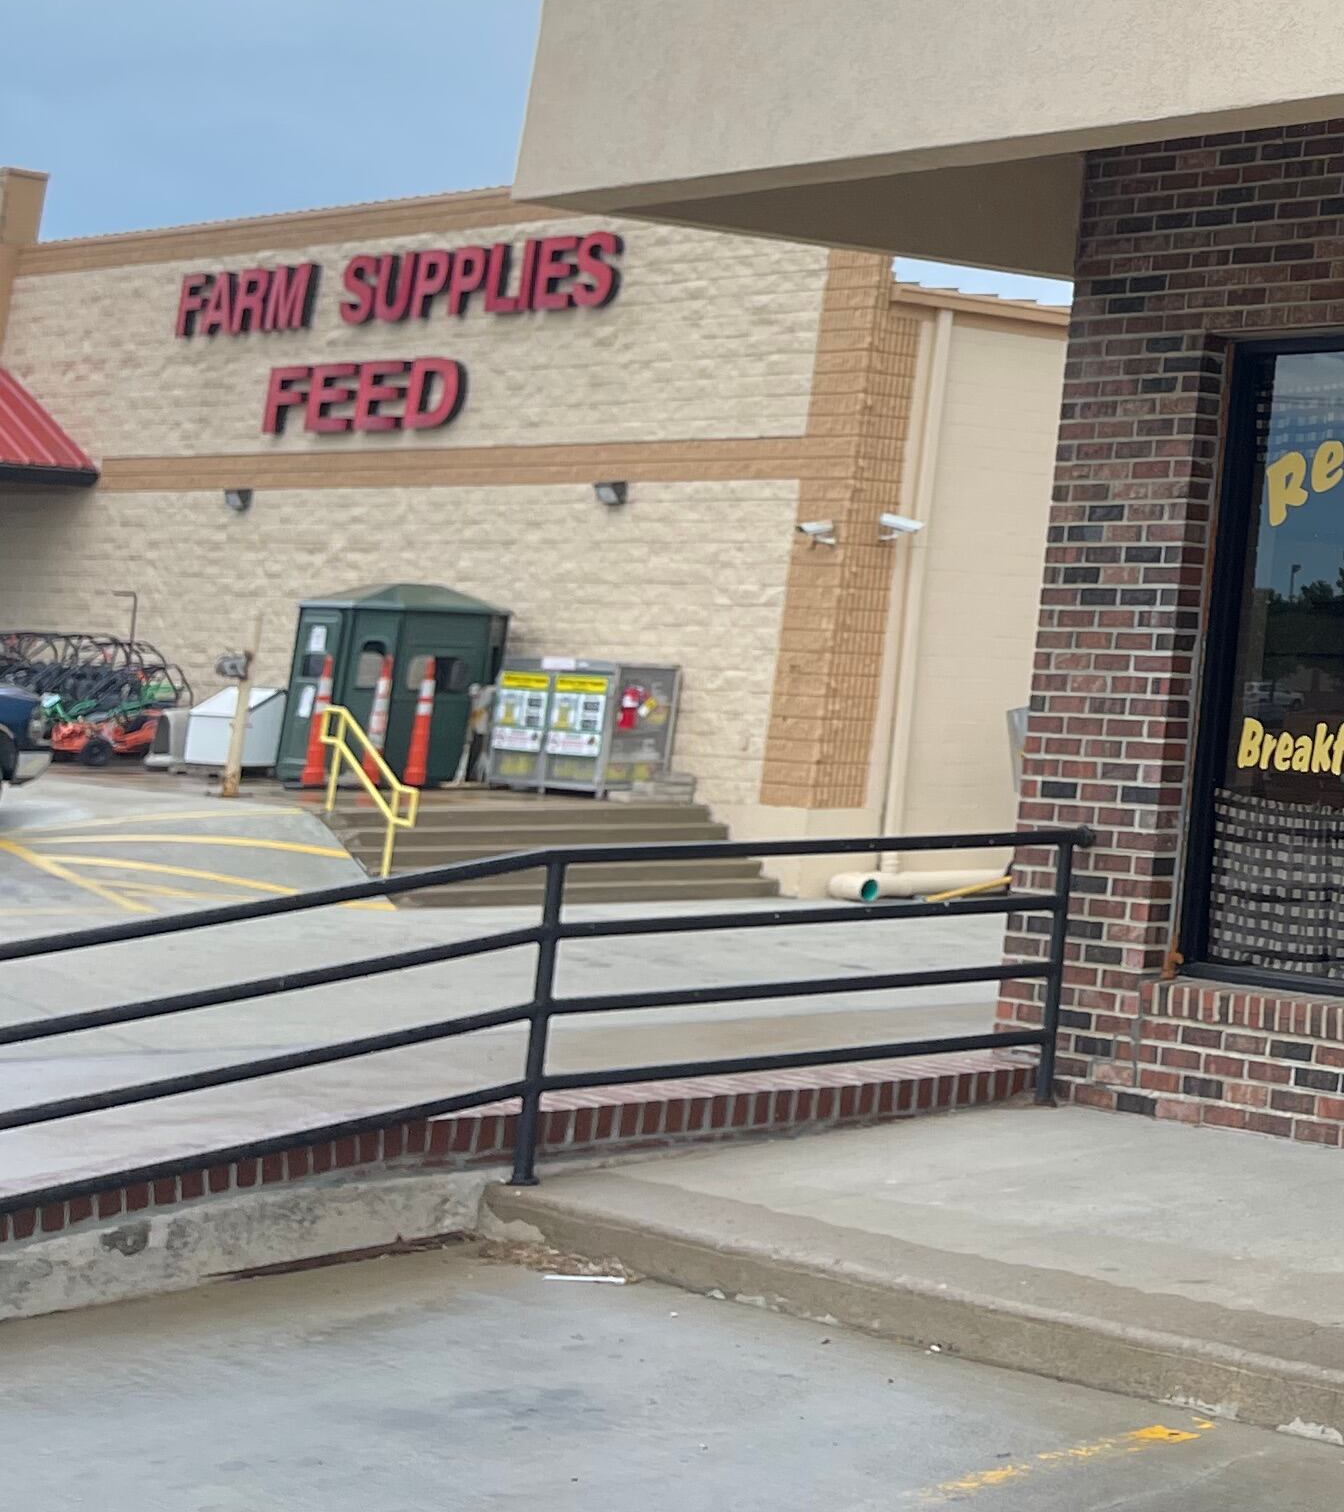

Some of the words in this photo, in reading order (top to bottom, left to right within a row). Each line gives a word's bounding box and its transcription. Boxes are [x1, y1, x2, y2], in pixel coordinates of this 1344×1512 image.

[175, 263, 318, 338] FARM
[340, 231, 622, 326] SUPPLIES
[262, 356, 464, 435] FEED
